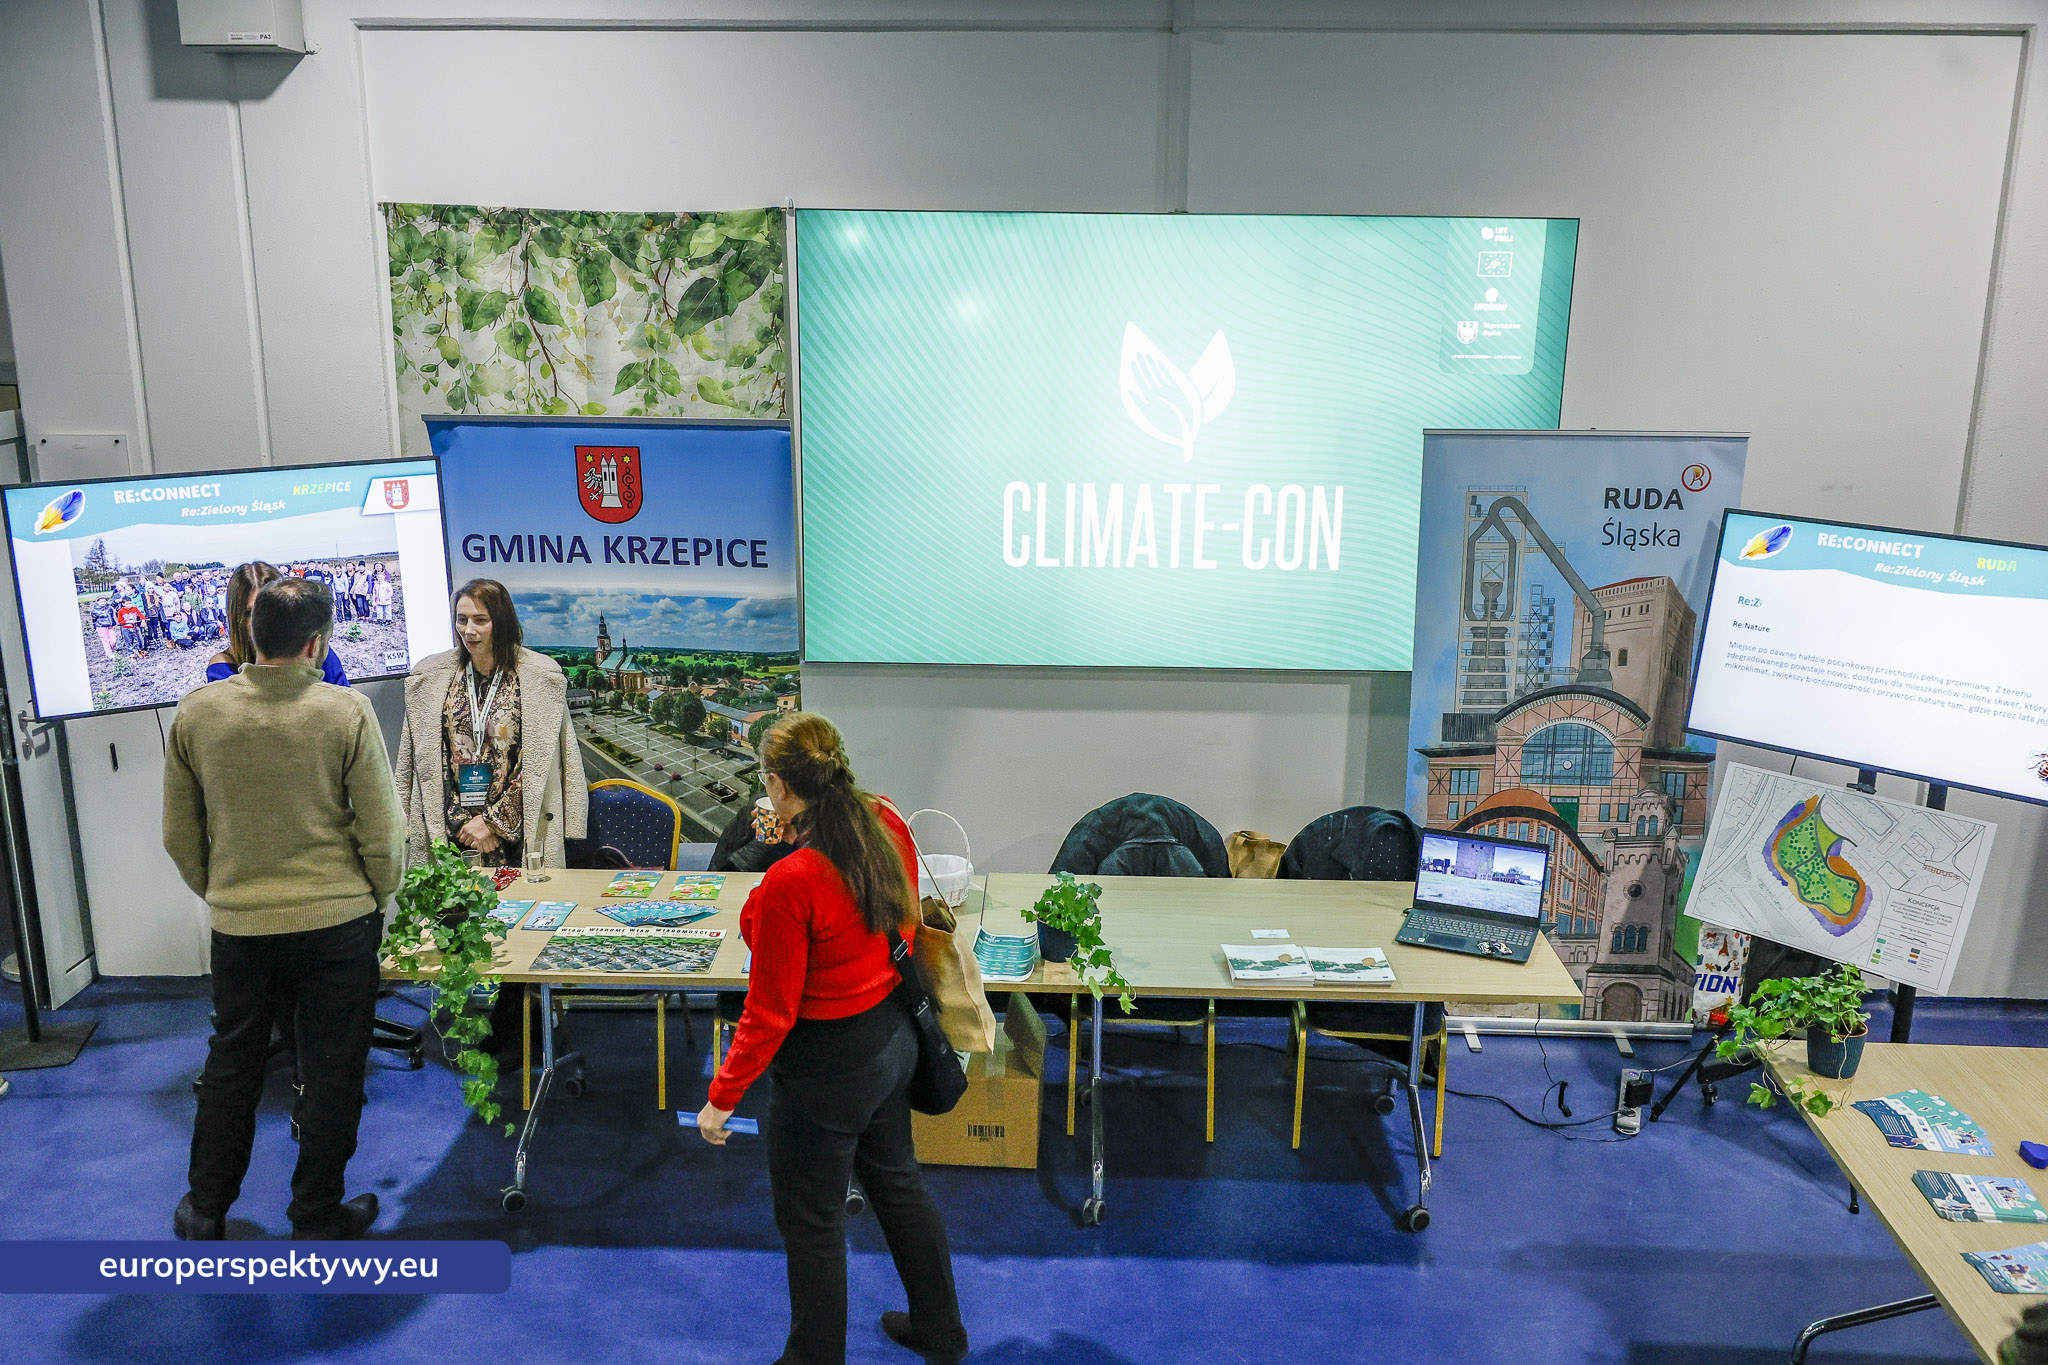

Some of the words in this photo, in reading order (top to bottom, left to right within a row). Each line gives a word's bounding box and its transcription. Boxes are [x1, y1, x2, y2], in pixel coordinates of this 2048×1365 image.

[113, 483, 222, 504] RE:CONNECT
[292, 481, 352, 496] KRZEPICE
[181, 500, 248, 518] Re:Zielony
[251, 499, 286, 514] Śląsk
[1603, 486, 1684, 511] RUDA
[1002, 480, 1345, 572] CLIMATE-CON
[1601, 517, 1680, 552] Śląska
[462, 534, 592, 564] GMINA
[604, 535, 769, 568] KRZEPICE
[1817, 532, 1924, 559] RE:CONNECT
[1976, 557, 2017, 572] RUDA
[1874, 562, 1944, 584] Re:Zielony
[1946, 570, 1988, 588] Śląsk
[1732, 620, 1770, 632] Re:Nature
[387, 652, 404, 660] KSW
[1729, 641, 1757, 653] Miejsce
[1758, 646, 1768, 654] po
[1770, 647, 1797, 660] dawnej
[1799, 652, 1826, 664] hałdzie
[1827, 658, 1874, 674] pocynkowej
[1876, 667, 1920, 680] przechodzi
[1920, 674, 1944, 686] pełną
[1995, 685, 2001, 694] Z
[2002, 686, 2032, 699] terenu
[1724, 661, 1770, 676] mikroklimat,
[1772, 668, 1805, 683] zwiększy
[1947, 700, 1966, 711] tam,
[1968, 704, 1992, 714] gdzie
[1993, 708, 2017, 720] przez
[2018, 712, 2035, 723] lata
[1726, 652, 1789, 669] zdegradowanego
[1790, 660, 1825, 676] powstaje
[1827, 669, 1850, 681] nowy,
[1852, 673, 1889, 687] dostępny
[1890, 679, 1903, 688] dla
[1905, 682, 1960, 698] mieszkańców
[1961, 691, 1992, 705] zielony
[2024, 702, 2048, 714] który
